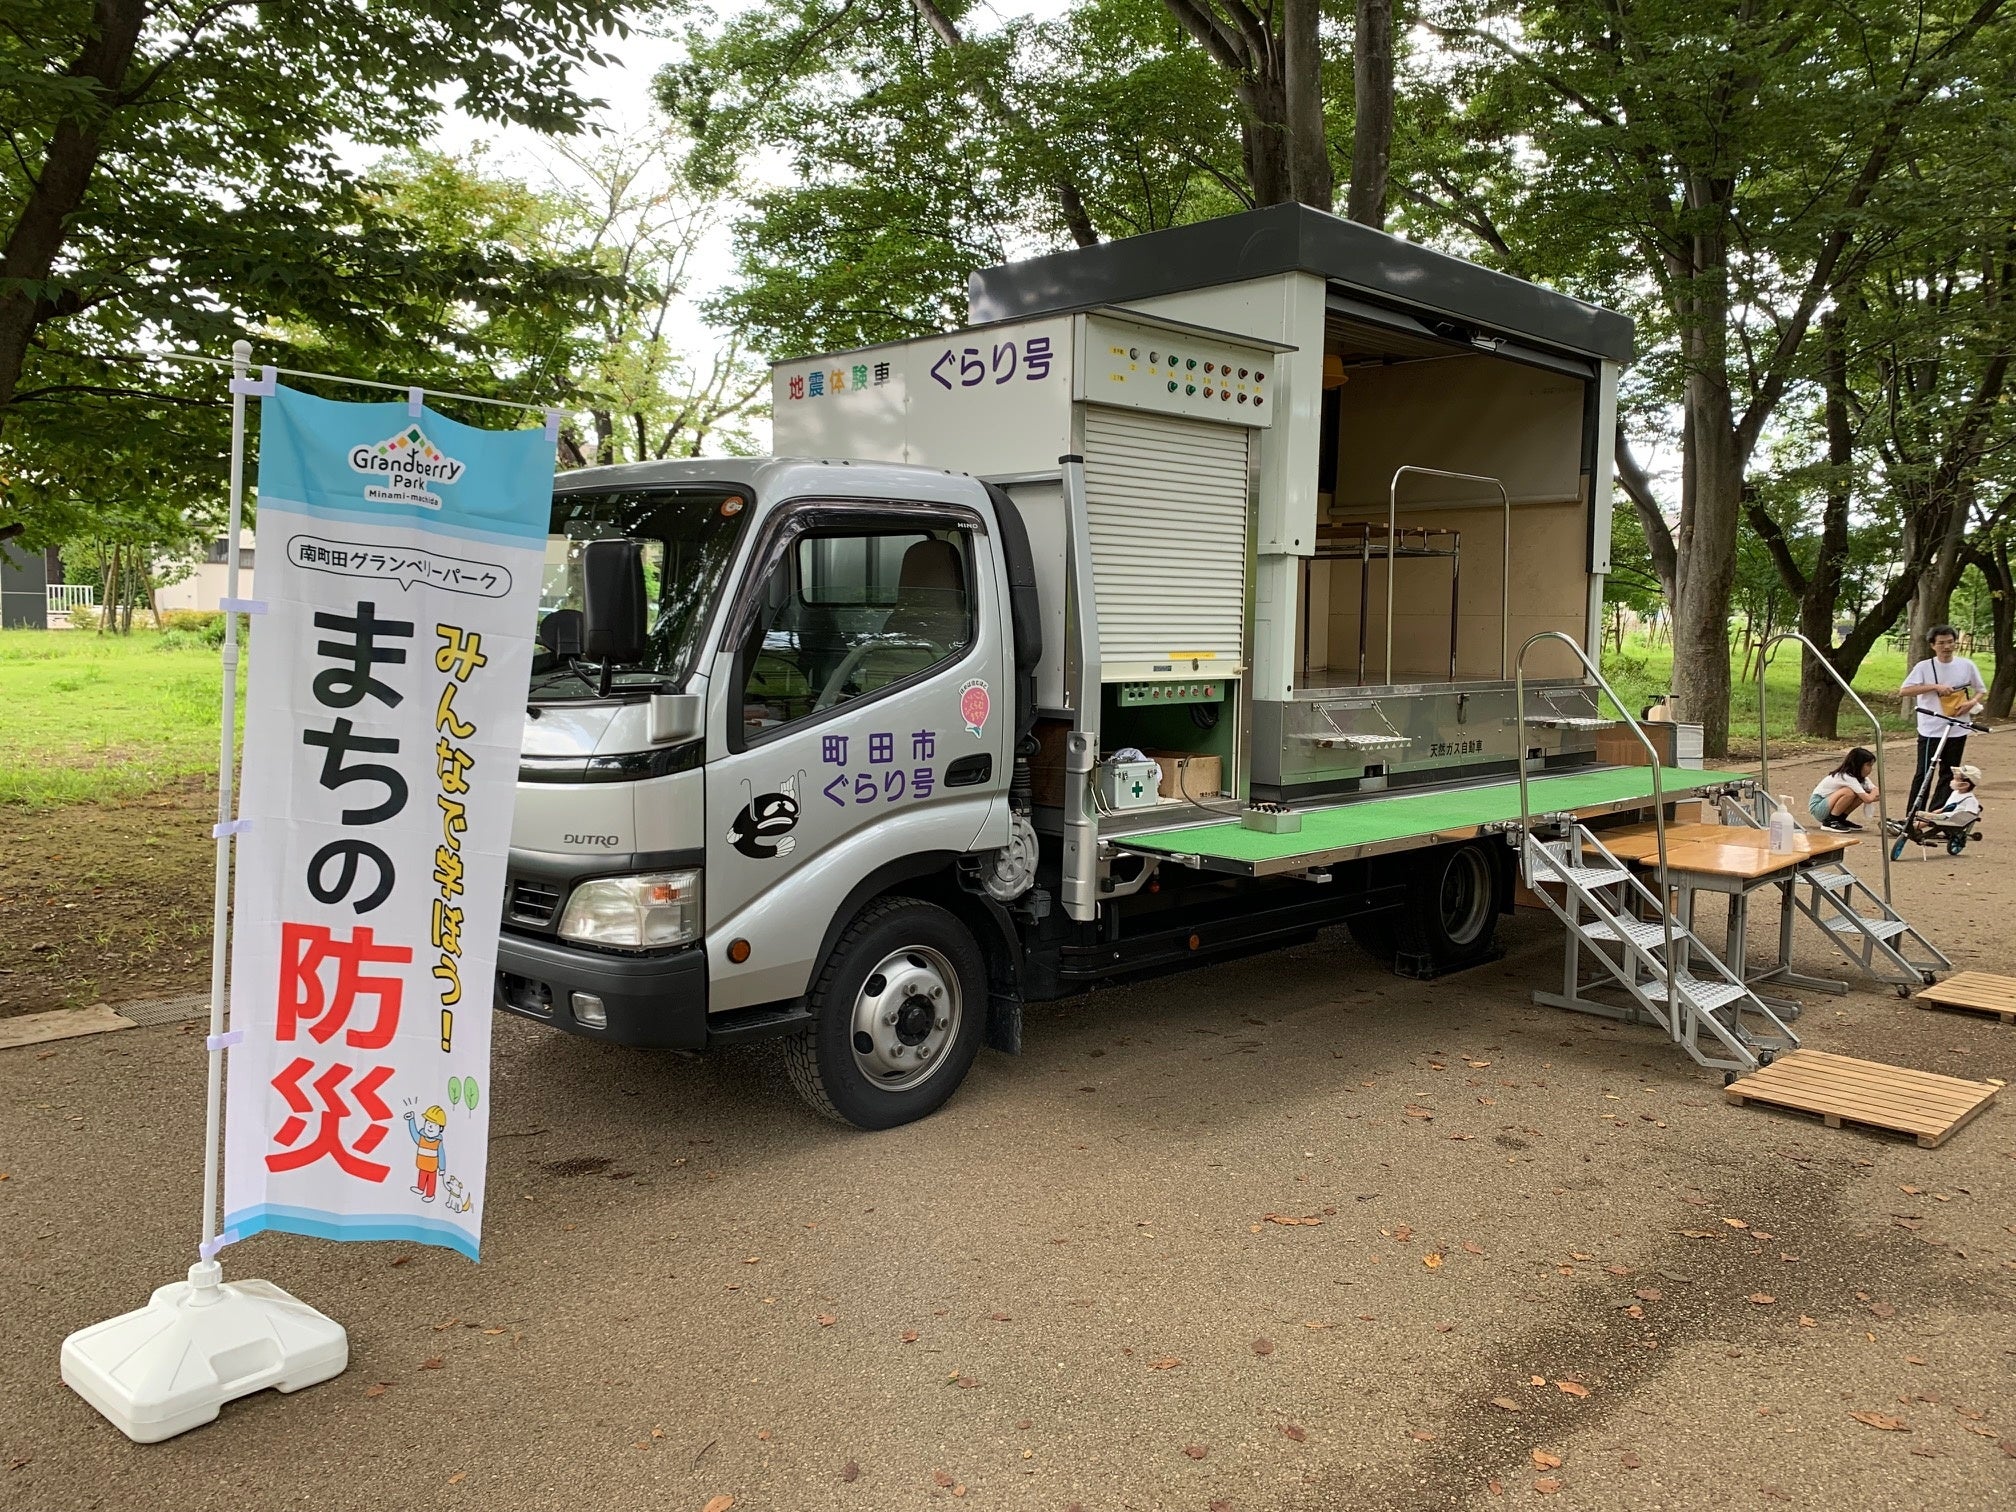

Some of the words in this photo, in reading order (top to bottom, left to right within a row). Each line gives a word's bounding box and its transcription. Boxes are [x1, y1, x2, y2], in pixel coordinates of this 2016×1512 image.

[789, 361, 891, 400] 地震体験車
[930, 336, 1054, 391] ぐらり号
[353, 448, 462, 480] Grandberry
[394, 475, 425, 491] Park
[369, 489, 439, 506] Minami-machida
[299, 544, 498, 590] 南町田グランベリーパーク
[822, 729, 936, 767] 町田市
[1429, 739, 1483, 758] 天然ガス自動車
[823, 767, 935, 807] ぐらり号
[563, 833, 619, 848] DUTRO
[264, 600, 415, 1184] まちの防災
